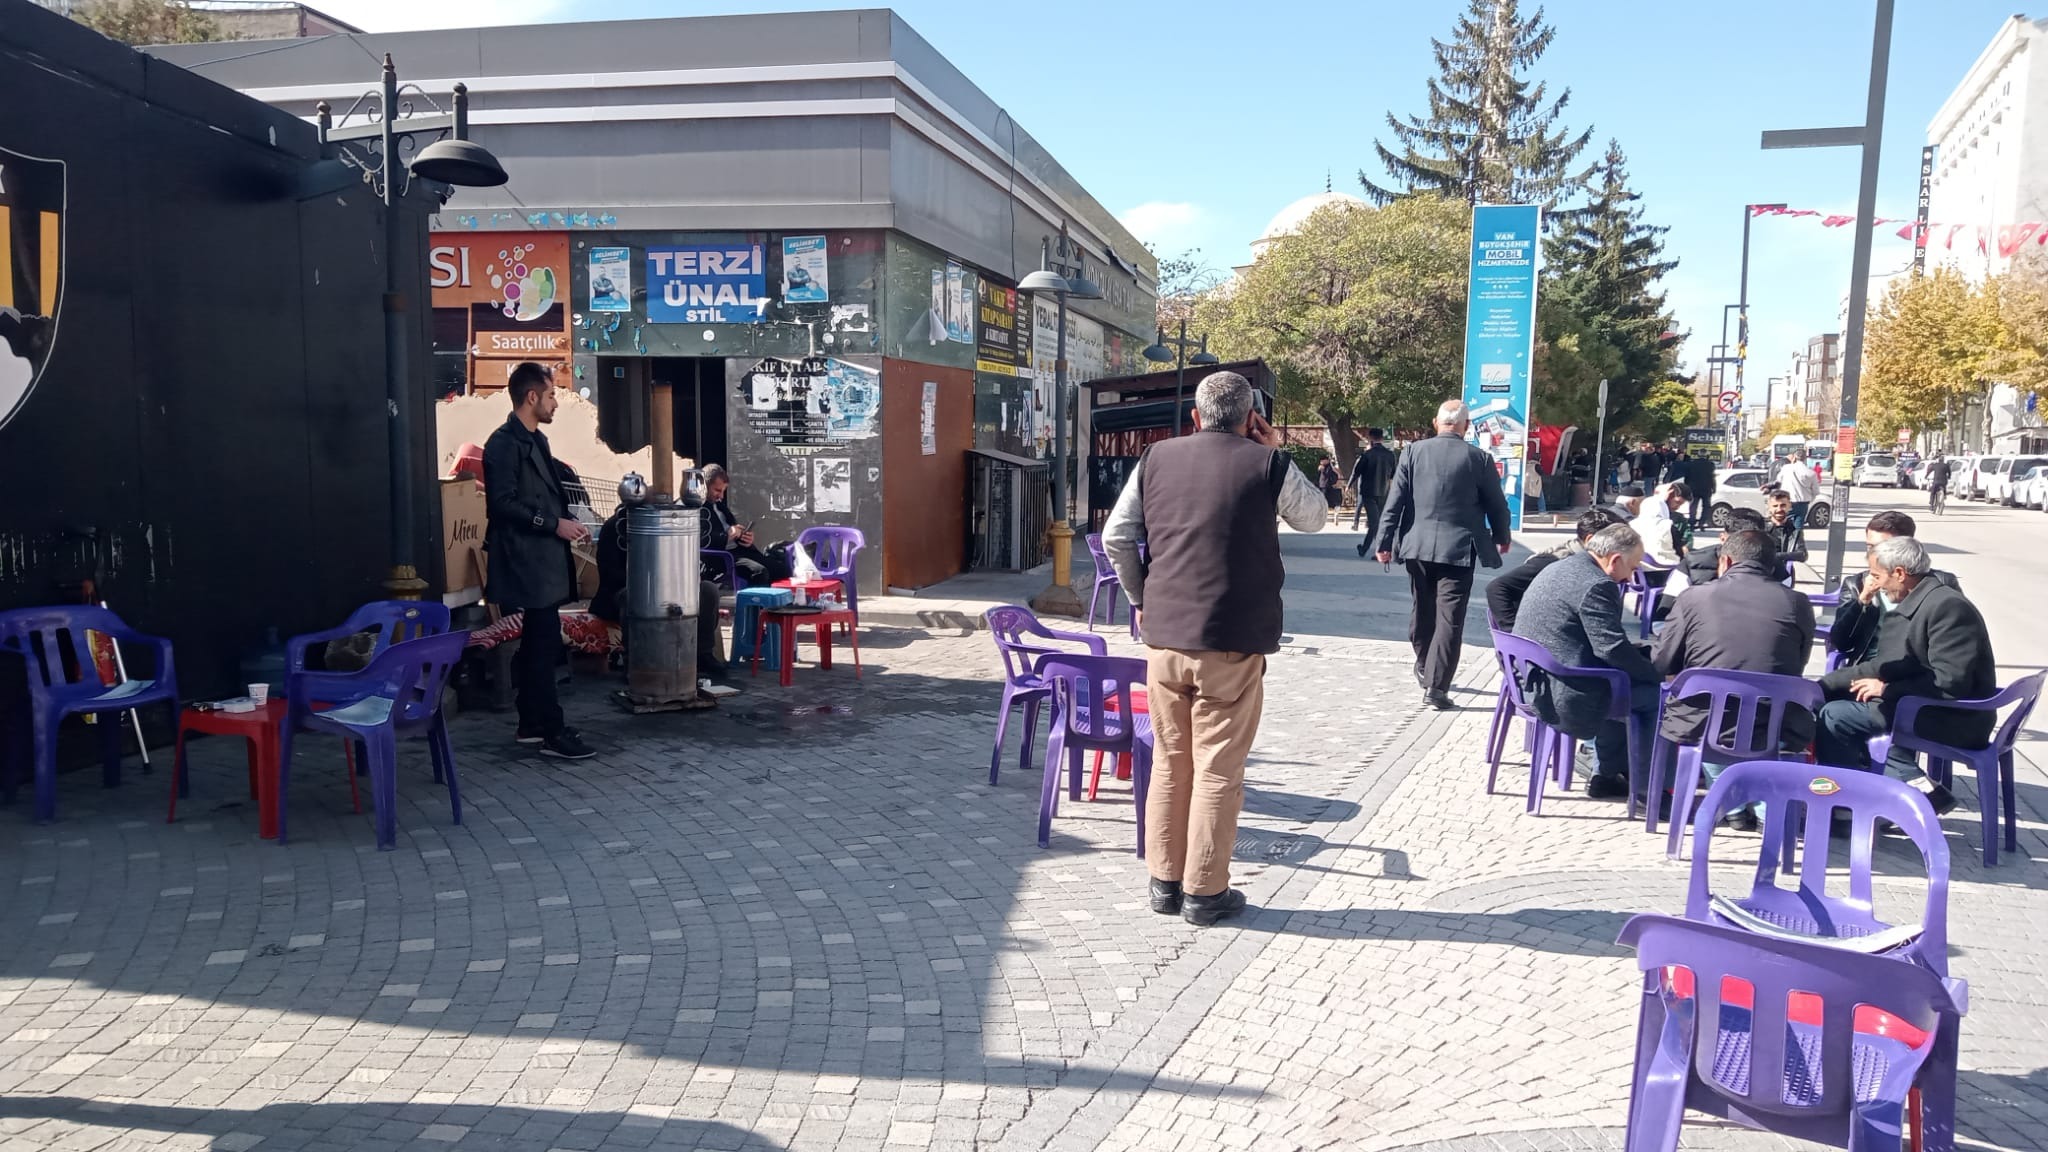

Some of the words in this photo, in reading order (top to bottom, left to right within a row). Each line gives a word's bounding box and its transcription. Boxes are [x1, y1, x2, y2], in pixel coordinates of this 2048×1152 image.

[1919, 164, 1932, 208] STAR
[1495, 232, 1515, 241] VAN
[1916, 215, 1928, 258] LIE
[648, 245, 762, 276] TERZİ
[663, 279, 759, 307] ÜNAL
[686, 307, 727, 322] STİL
[491, 334, 556, 353] Saatçılık
